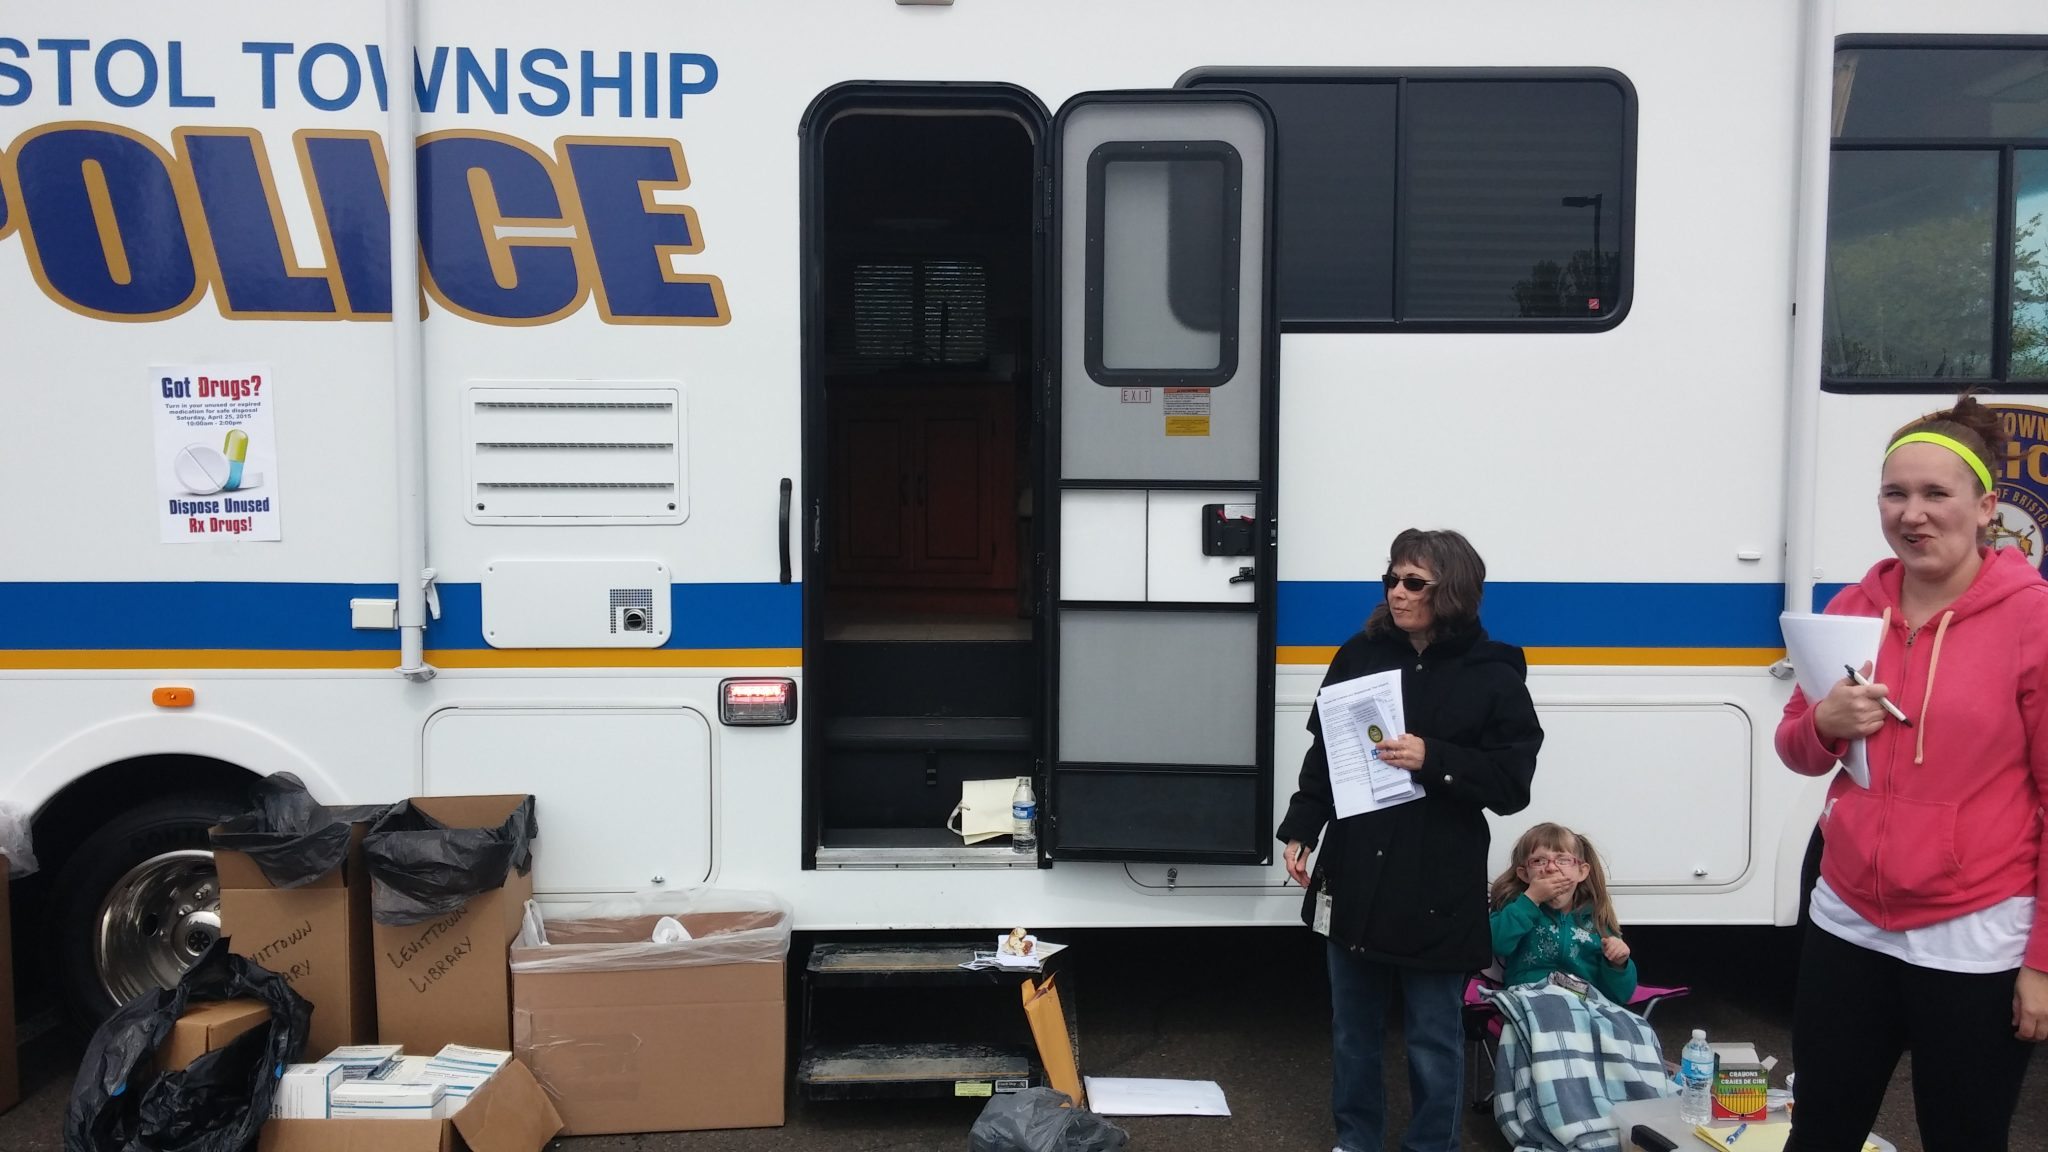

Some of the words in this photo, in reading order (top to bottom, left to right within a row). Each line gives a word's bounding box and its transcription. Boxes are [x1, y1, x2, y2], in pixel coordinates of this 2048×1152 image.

[242, 42, 720, 119] TOWNSHIP
[0, 120, 731, 326] OLICE
[161, 377, 191, 399] Got
[198, 375, 262, 401] Drugs?
[1123, 390, 1149, 402] EXIT
[231, 407, 258, 415] disposal
[169, 499, 220, 517] Dispose
[224, 496, 270, 513] Unused
[189, 517, 205, 533] Rx
[209, 516, 253, 535] Drugs!
[386, 907, 469, 970] LEVITTOWN
[408, 935, 473, 994] LIBRARY
